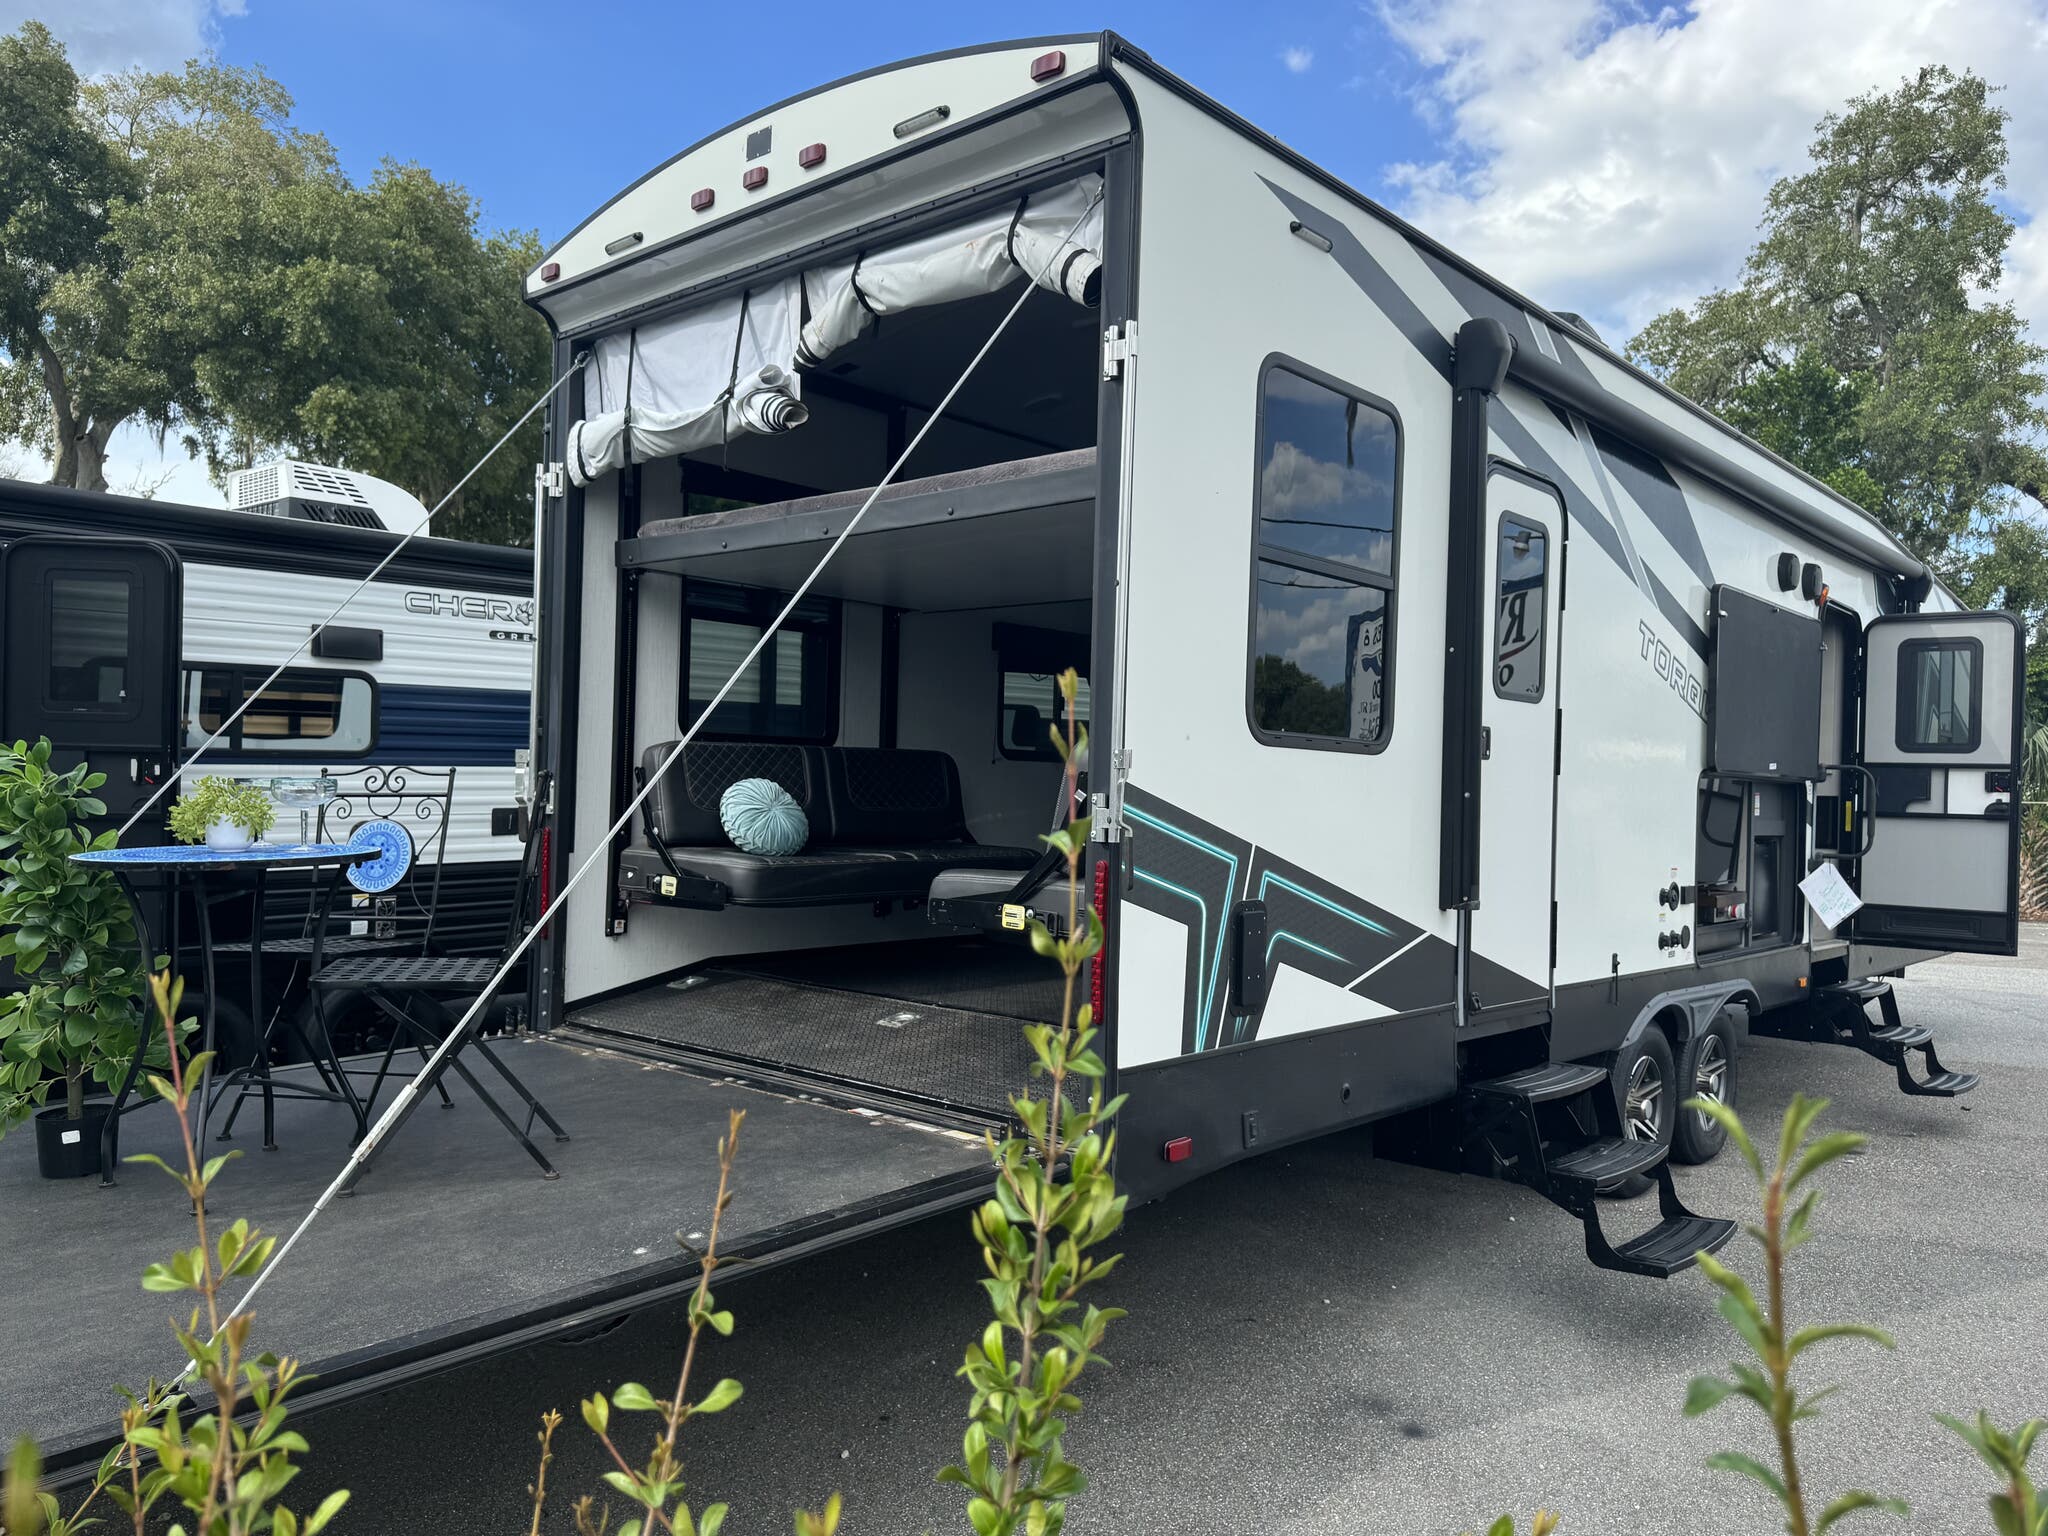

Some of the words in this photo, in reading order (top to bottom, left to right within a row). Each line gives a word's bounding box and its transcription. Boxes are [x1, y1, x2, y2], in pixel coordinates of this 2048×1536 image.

[405, 591, 534, 626] CHER
[496, 631, 531, 642] GRE
[1639, 618, 1708, 724] TORQ
